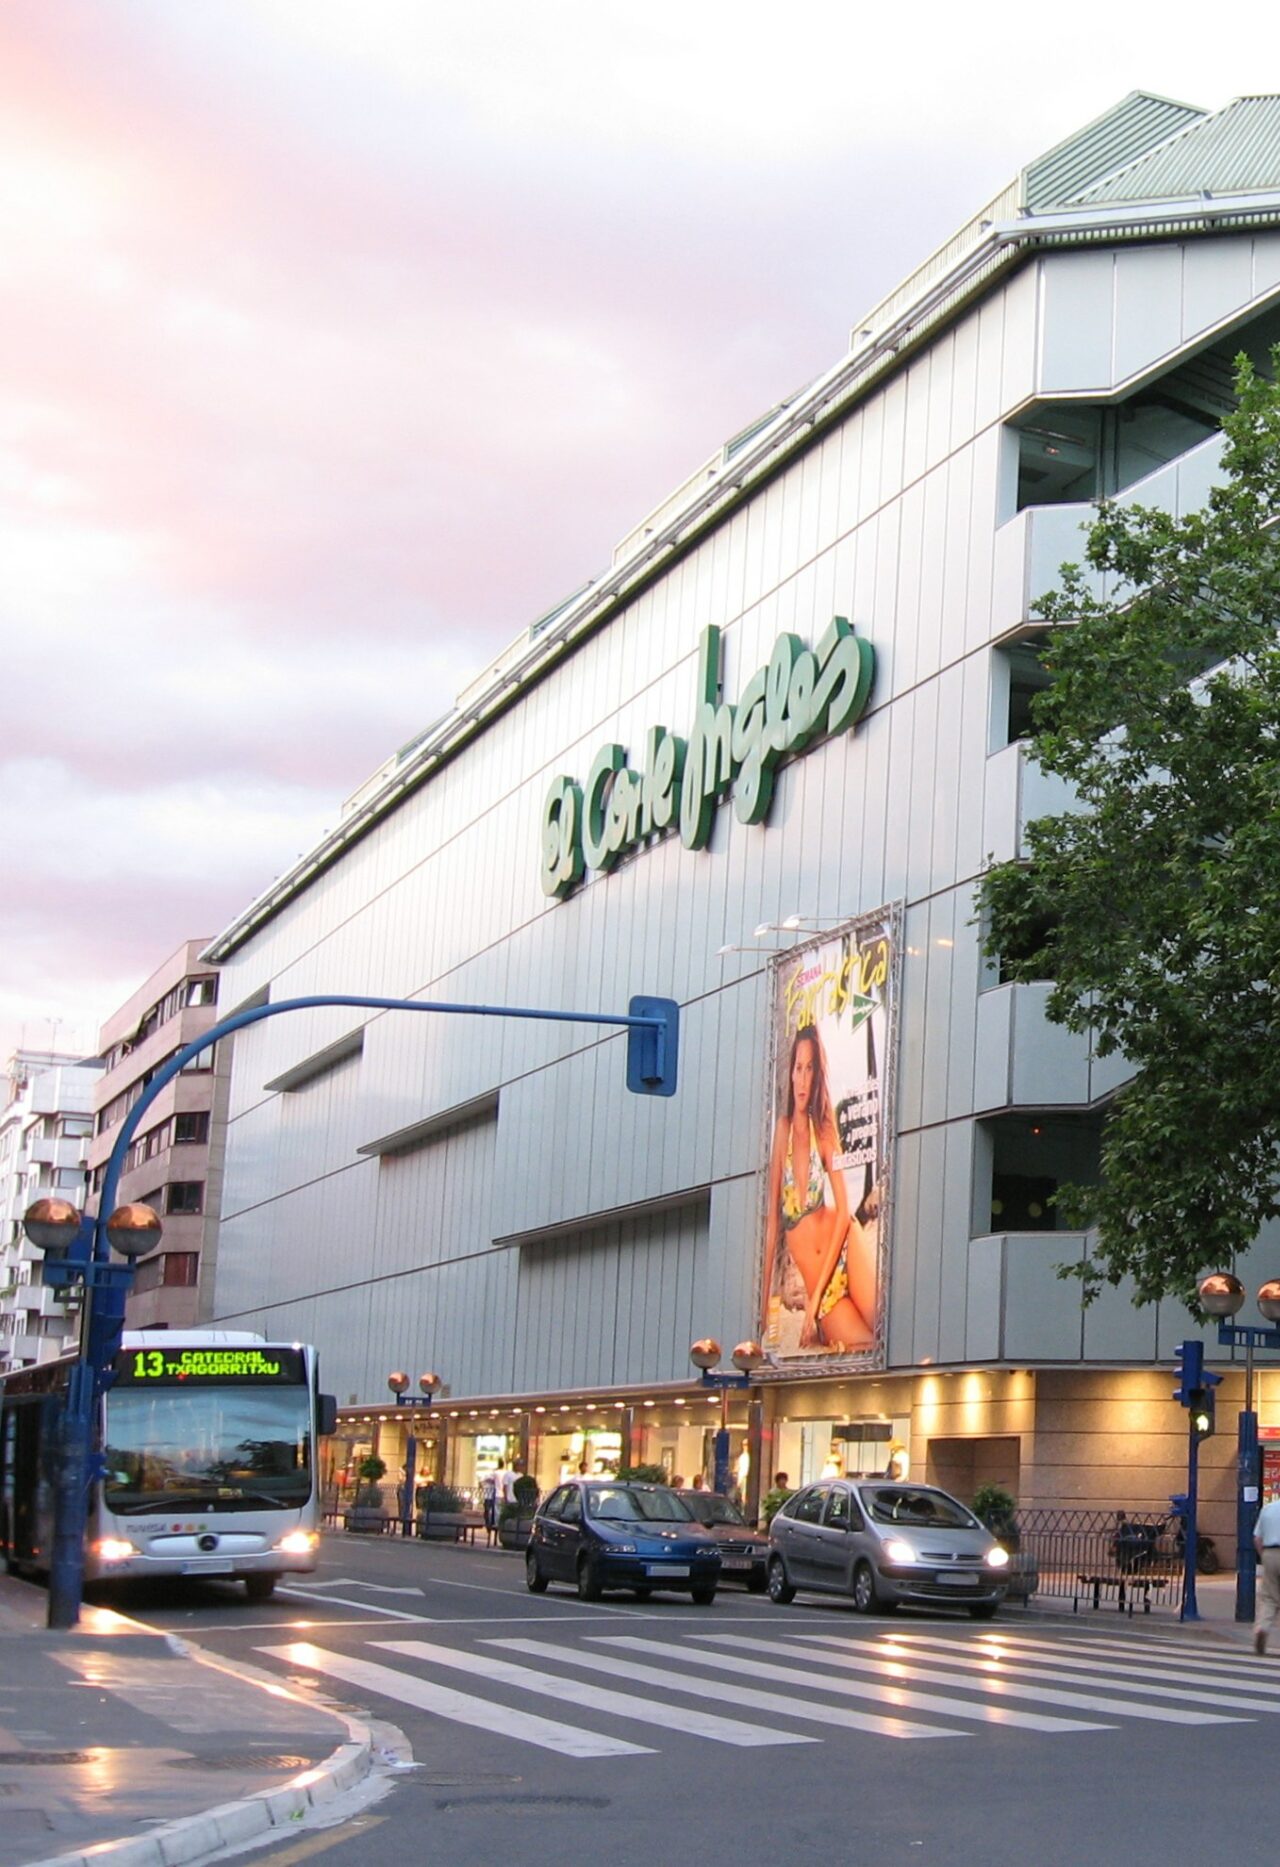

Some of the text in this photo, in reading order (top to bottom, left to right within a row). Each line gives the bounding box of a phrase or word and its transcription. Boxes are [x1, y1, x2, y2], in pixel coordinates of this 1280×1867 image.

[582, 725, 688, 871] Corte
[847, 1098, 878, 1121] verano
[134, 1352, 164, 1377] 13
[181, 1352, 265, 1364] CATEDRAL
